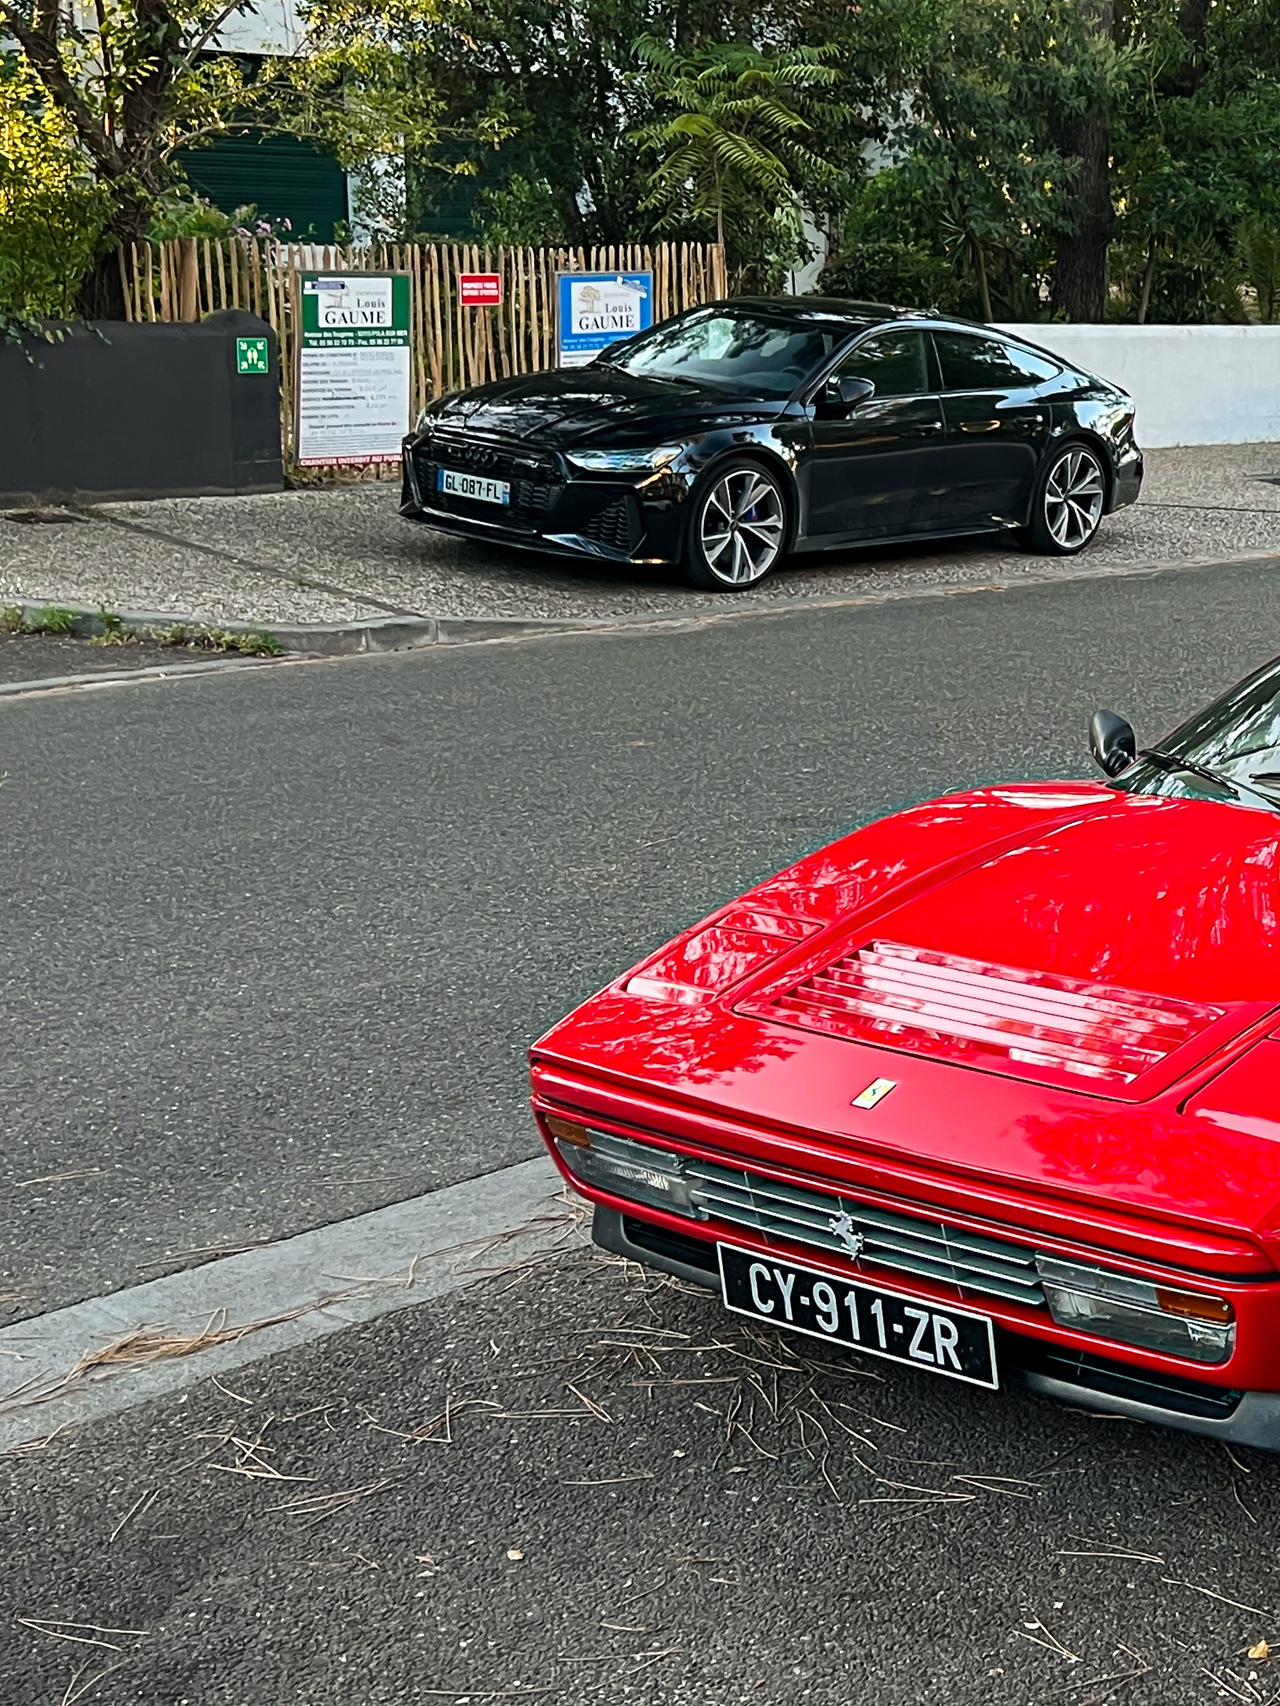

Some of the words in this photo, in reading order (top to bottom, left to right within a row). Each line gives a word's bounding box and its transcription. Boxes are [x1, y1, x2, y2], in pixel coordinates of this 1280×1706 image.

[357, 298, 386, 308] Louis
[605, 303, 633, 313] Louis
[325, 311, 386, 325] GAUME
[579, 315, 635, 331] GAUME
[445, 474, 501, 500] GL-087-FL
[749, 1262, 963, 1371] CY-911-ZR
